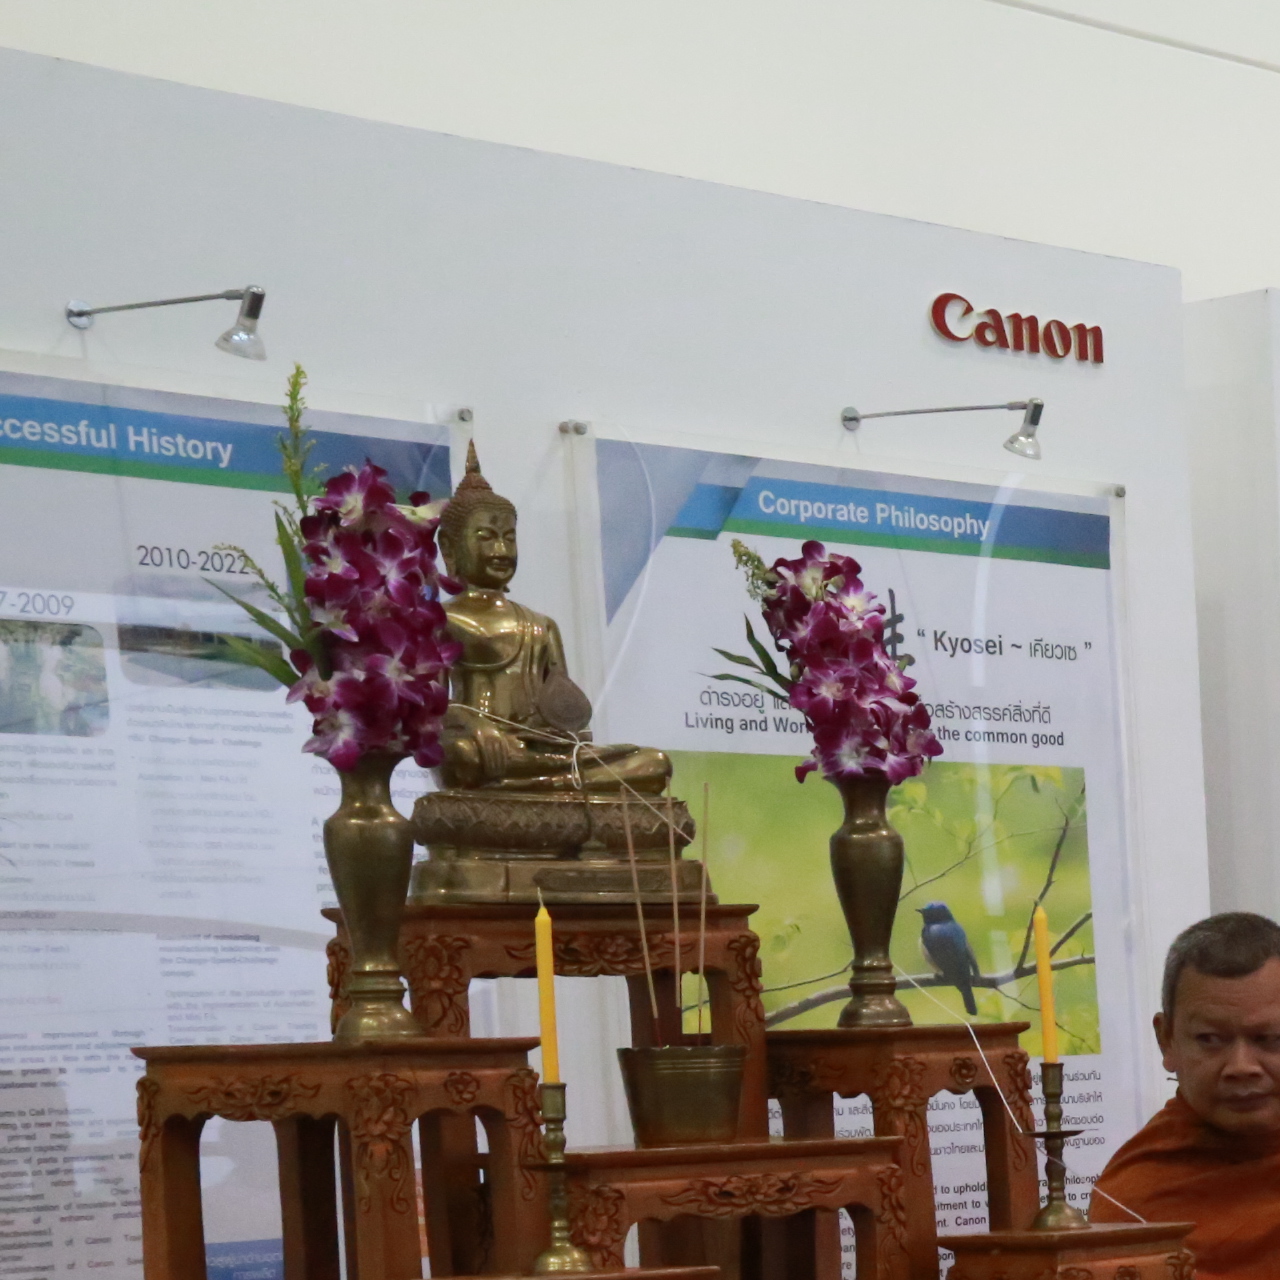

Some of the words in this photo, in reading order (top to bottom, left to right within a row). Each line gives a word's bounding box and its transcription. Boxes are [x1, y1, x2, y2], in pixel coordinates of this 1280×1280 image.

[930, 292, 1104, 363] Canon
[0, 418, 116, 449] cessful
[128, 425, 232, 467] History
[758, 490, 869, 524] Corporate
[875, 504, 990, 541] Philosophy
[137, 545, 249, 575] 2010-2022
[934, 630, 1003, 657] Kyosei
[685, 712, 734, 734] Living
[740, 717, 767, 731] and
[938, 726, 960, 740] the
[965, 730, 1027, 744] common
[1032, 732, 1064, 748] good
[941, 1185, 950, 1194] to
[1069, 1192, 1076, 1201] to
[936, 1201, 967, 1212] itment
[971, 1200, 981, 1209] to
[955, 1216, 986, 1226] Canon
